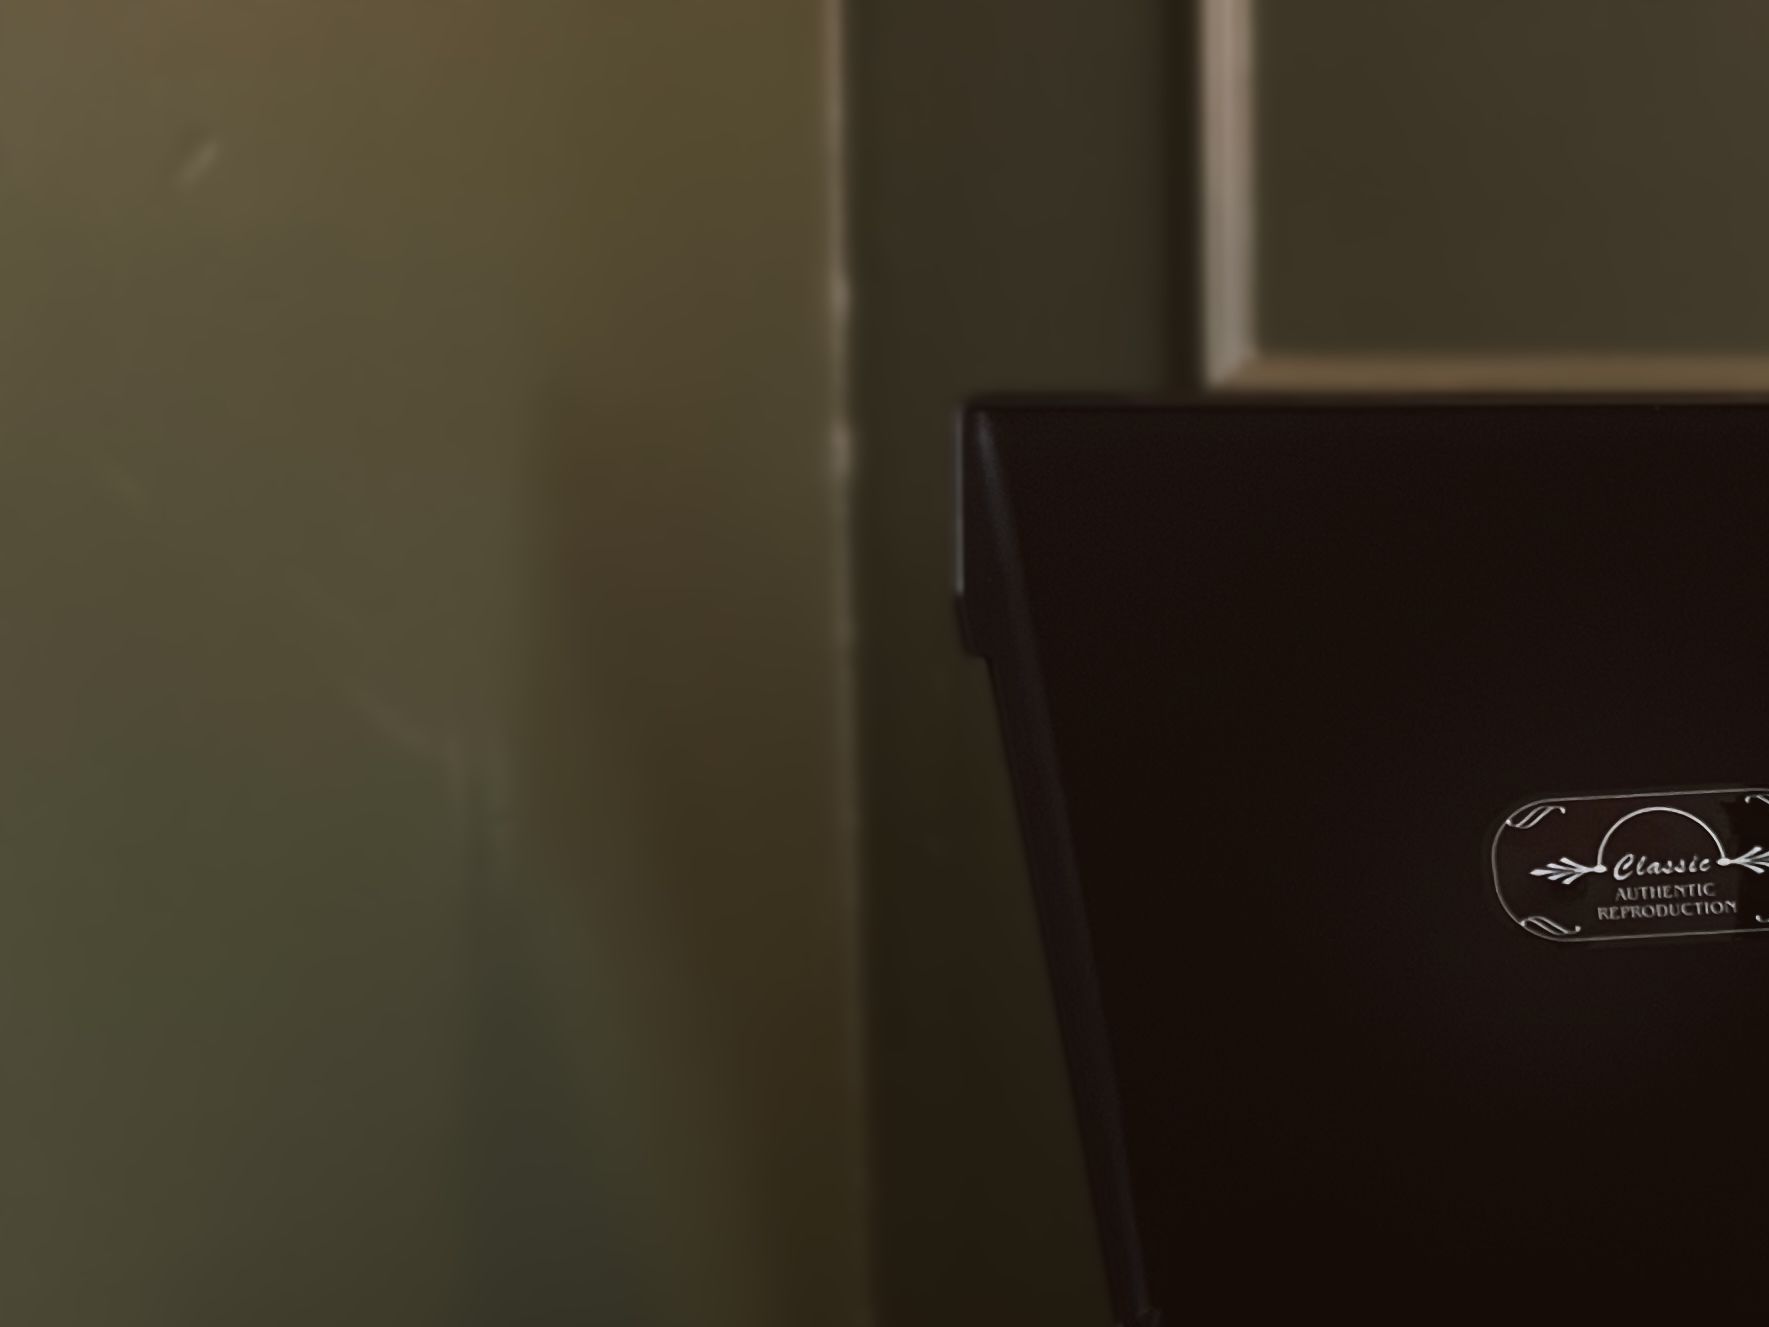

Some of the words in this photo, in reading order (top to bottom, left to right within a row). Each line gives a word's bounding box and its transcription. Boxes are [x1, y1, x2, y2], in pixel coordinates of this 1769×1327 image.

[1613, 854, 1711, 880] Classic
[1615, 882, 1716, 901] AUTHENTIC
[1597, 900, 1737, 920] REPRODUCTION
